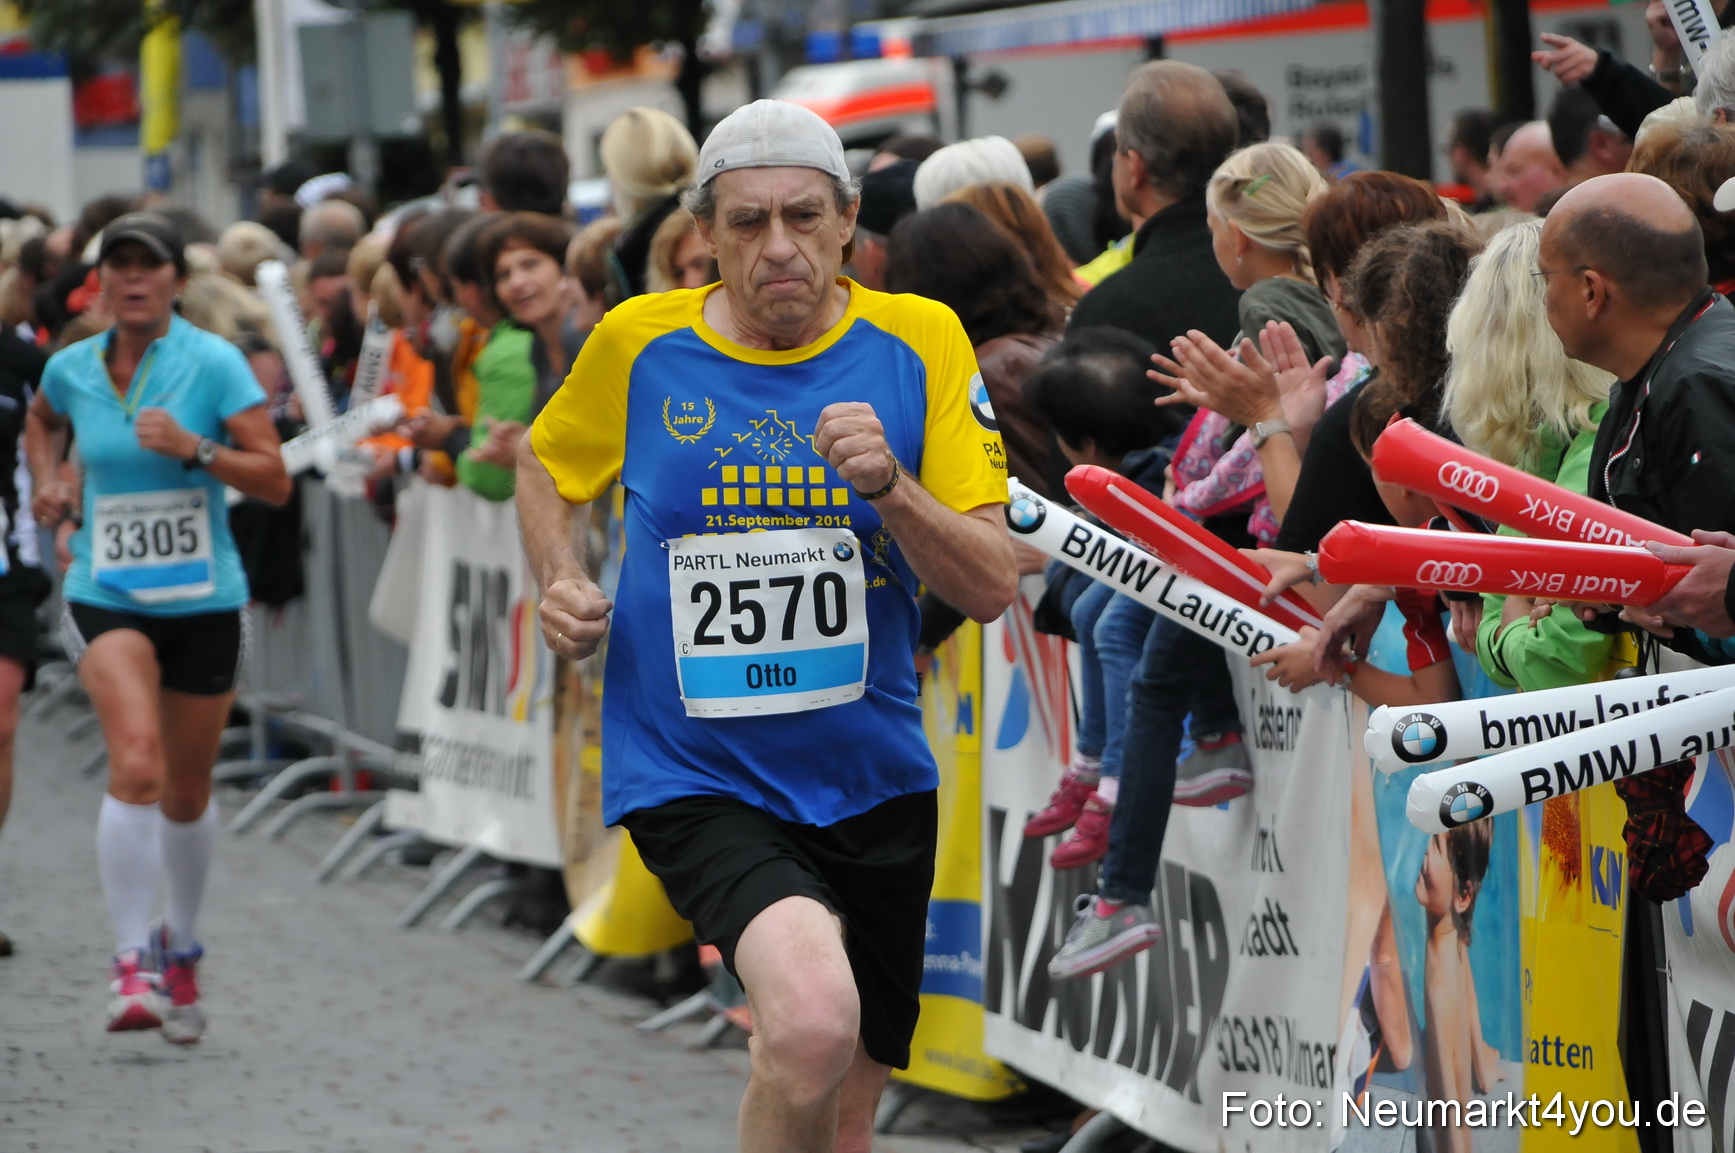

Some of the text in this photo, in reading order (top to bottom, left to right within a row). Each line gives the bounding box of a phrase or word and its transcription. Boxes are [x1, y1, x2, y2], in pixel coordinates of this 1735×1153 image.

[673, 414, 704, 425] Jahre
[681, 402, 695, 411] 15
[706, 514, 851, 528] 21.September 2014
[1519, 493, 1576, 532] BKK
[105, 515, 198, 560] 3305
[674, 547, 825, 571] PARTL Neumarkt
[1060, 523, 1161, 592] BMW
[1504, 569, 1641, 599] Audi BKK
[690, 571, 848, 646] 2570
[746, 663, 797, 689] Otto
[1520, 708, 1735, 805] BMW Lau
[1527, 1035, 1594, 1071] atten
